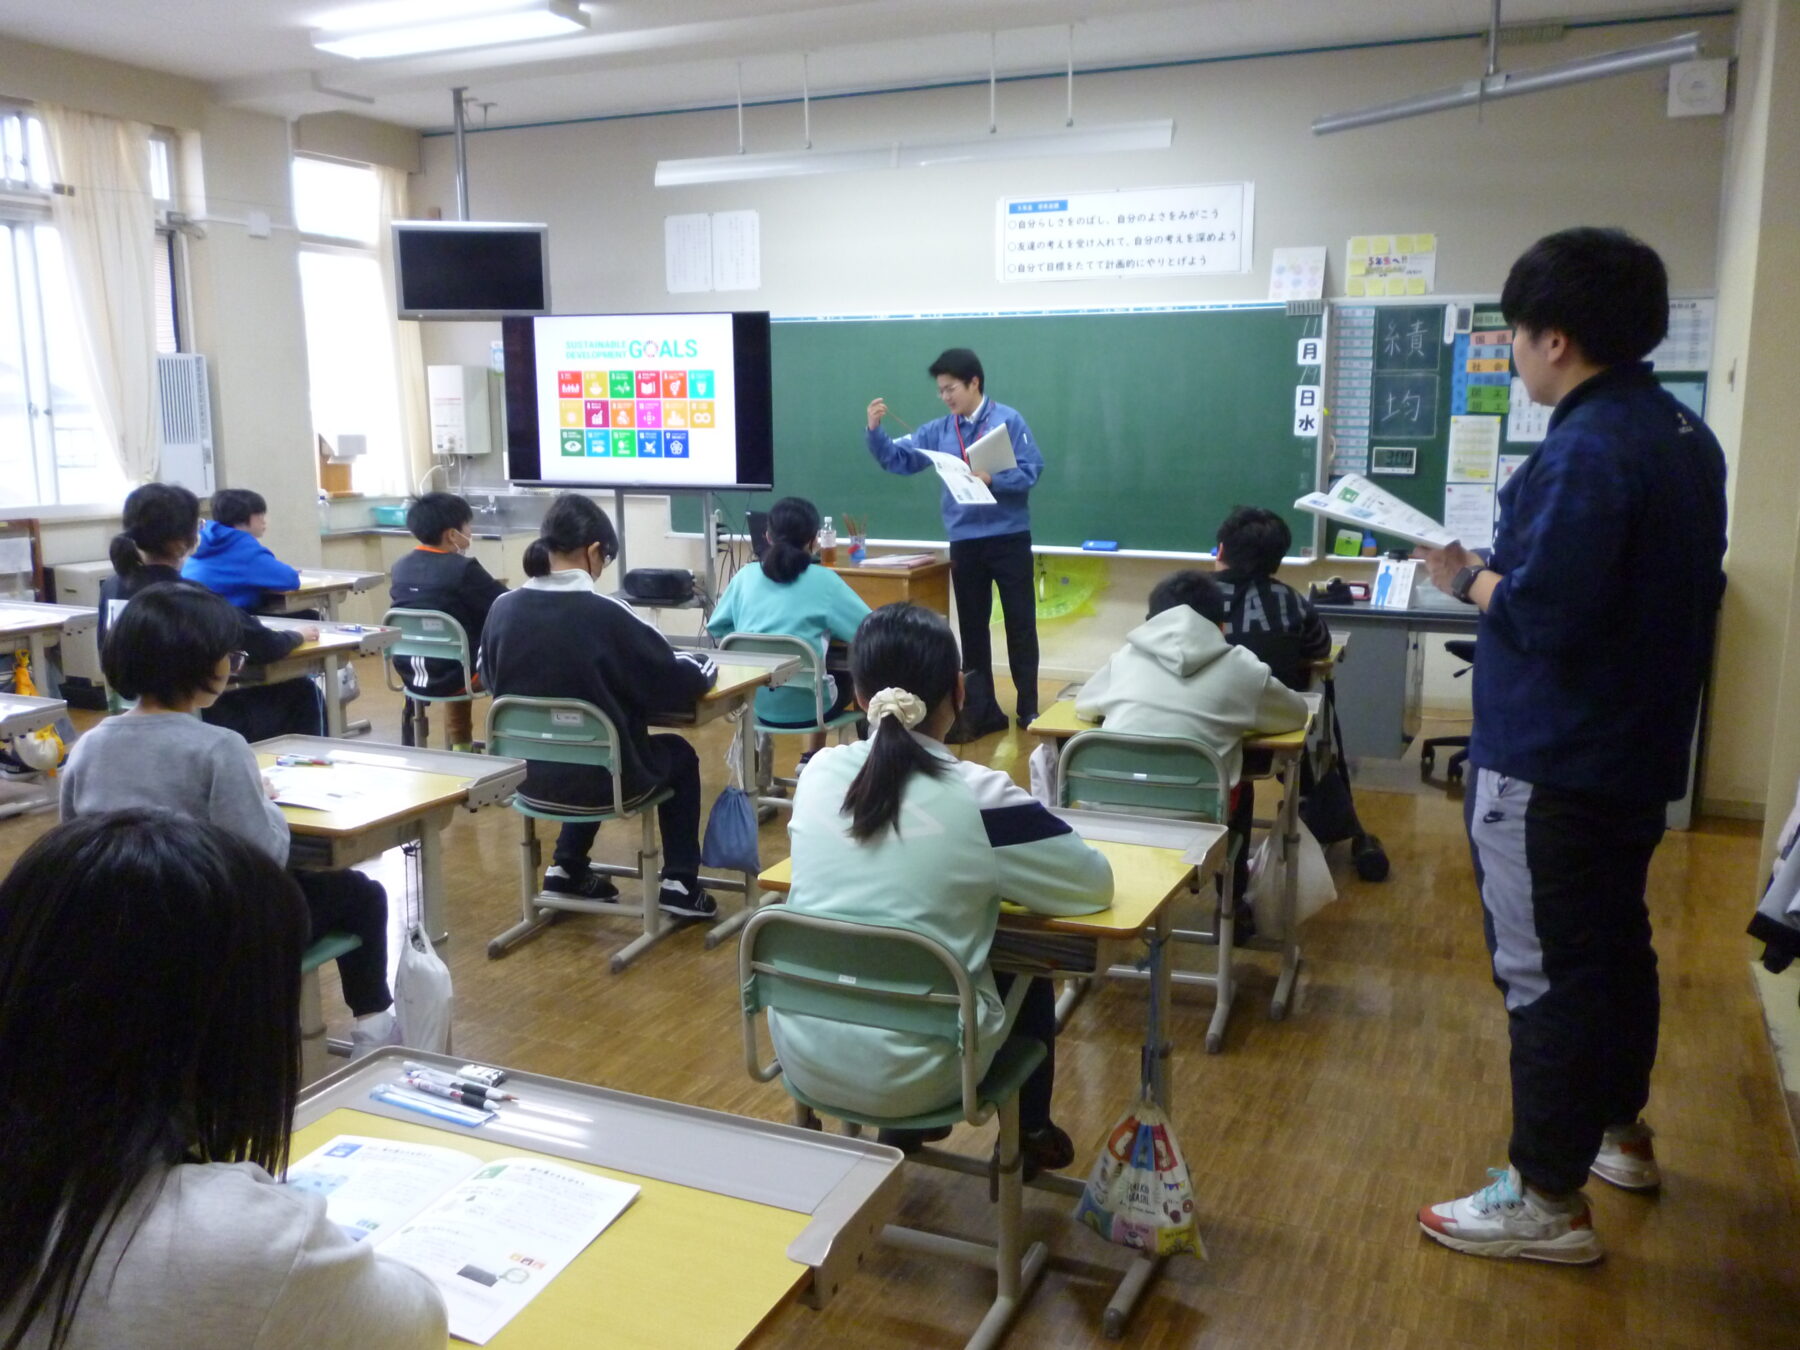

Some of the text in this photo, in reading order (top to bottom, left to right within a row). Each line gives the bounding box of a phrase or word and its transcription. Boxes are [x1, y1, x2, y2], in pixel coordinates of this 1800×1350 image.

[565, 340, 627, 349] SUSTAINABLE
[628, 339, 698, 359] GOALS
[565, 350, 627, 359] DEVELOPMENT
